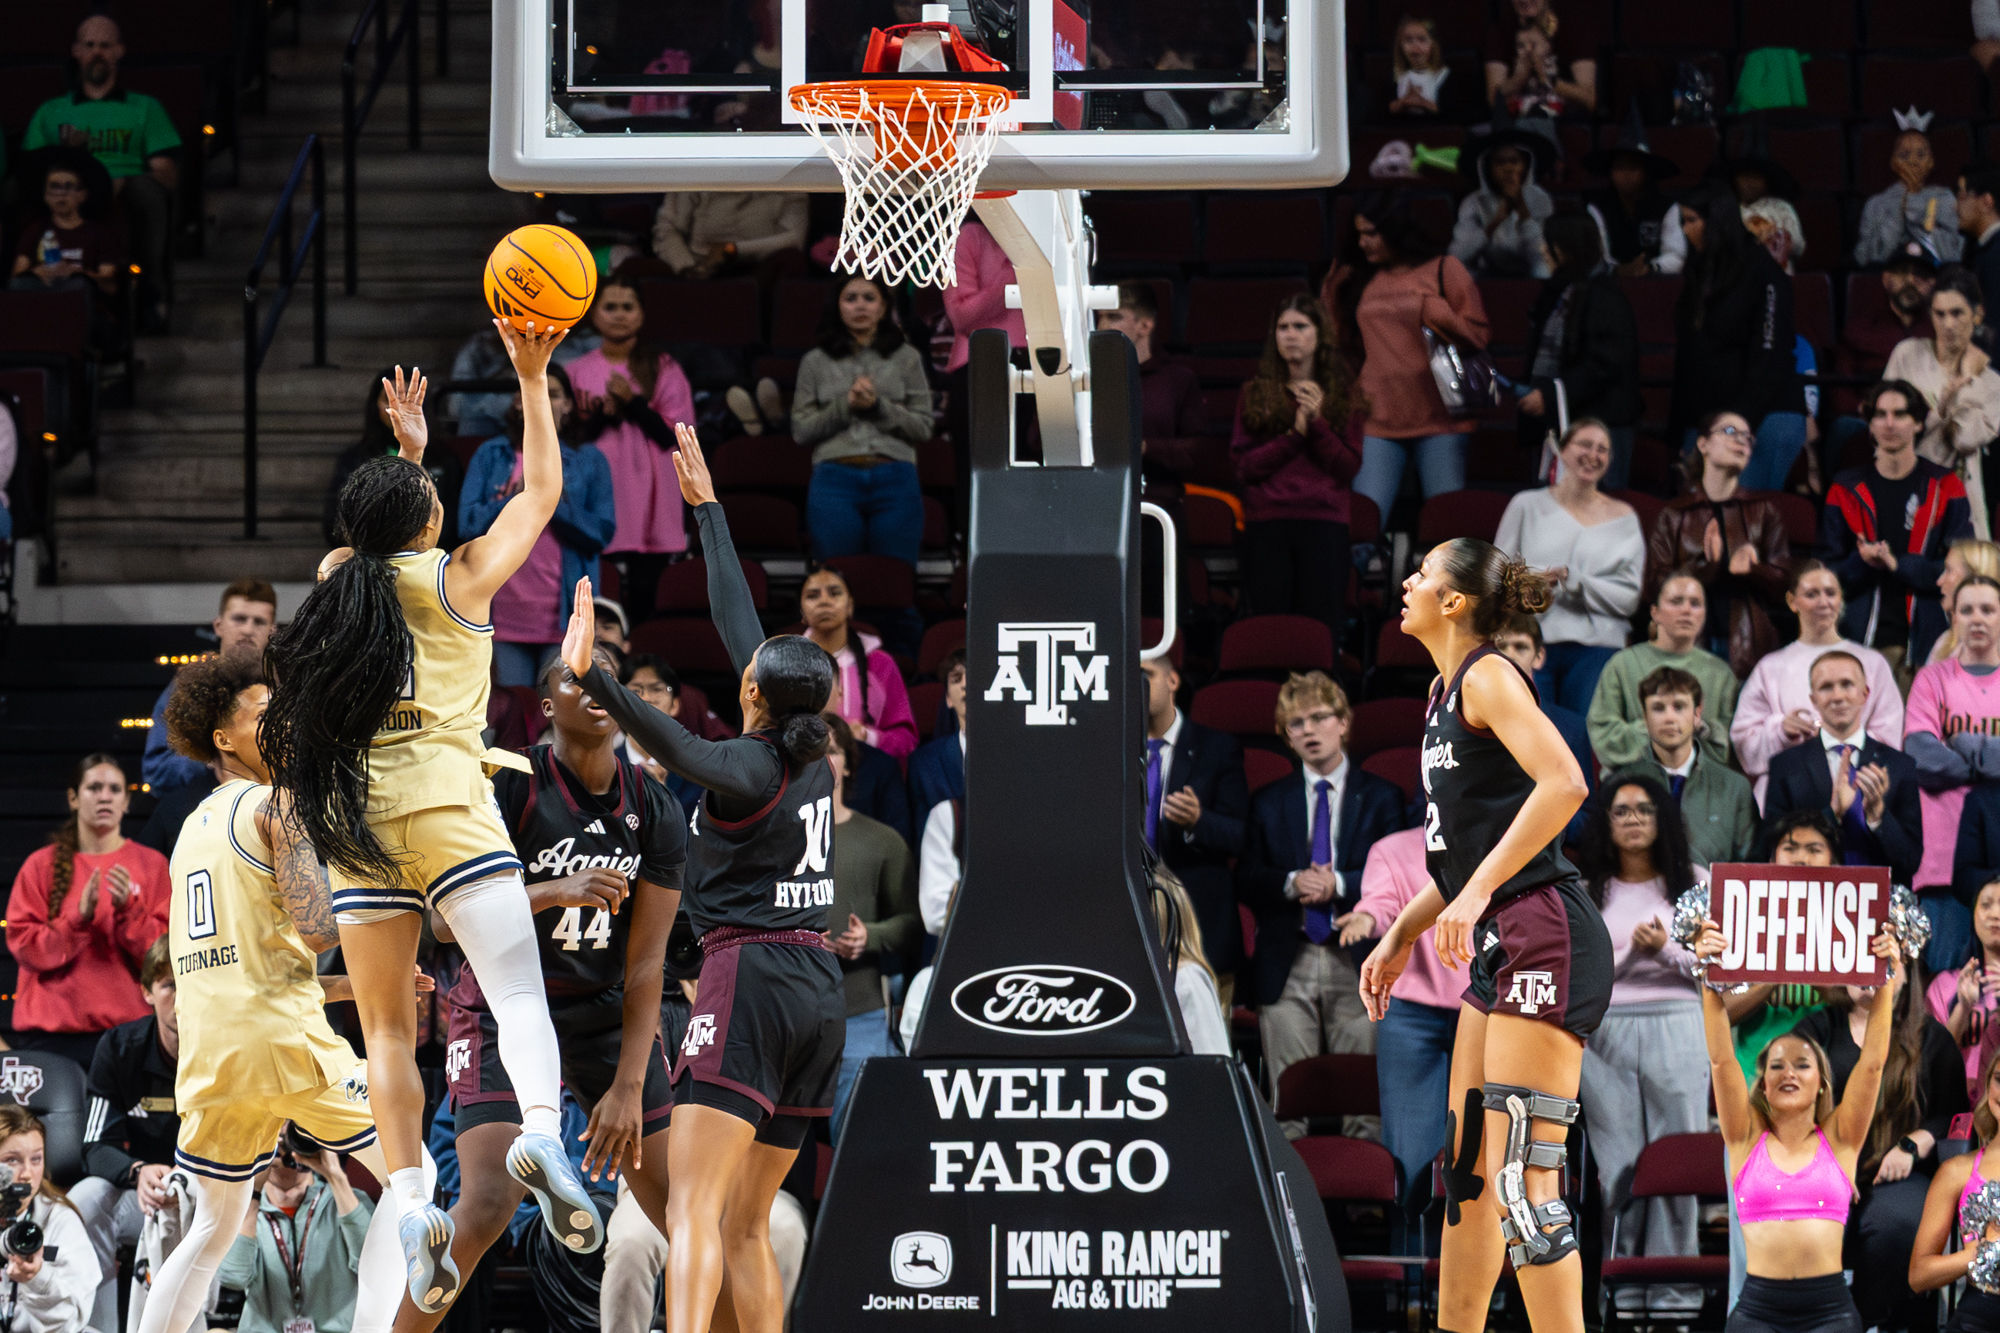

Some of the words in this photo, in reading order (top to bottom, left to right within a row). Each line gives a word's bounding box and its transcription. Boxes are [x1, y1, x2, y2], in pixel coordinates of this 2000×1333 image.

[505, 267, 540, 300] PRO
[793, 795, 832, 876] 10
[187, 868, 217, 940] 0
[551, 906, 612, 951] 44
[1721, 878, 1878, 974] DEFENSE
[178, 944, 239, 975] TURNAGE
[983, 973, 1104, 1024] Ford
[922, 1066, 1169, 1120] WELLS
[929, 1139, 1170, 1193] FARGO
[1007, 1230, 1091, 1277] KING
[862, 1293, 915, 1311] JOHN
[917, 1293, 981, 1311] DEERE
[1051, 1279, 1087, 1309] AG
[1089, 1278, 1111, 1309] &
[1110, 1278, 1174, 1309] TURF
